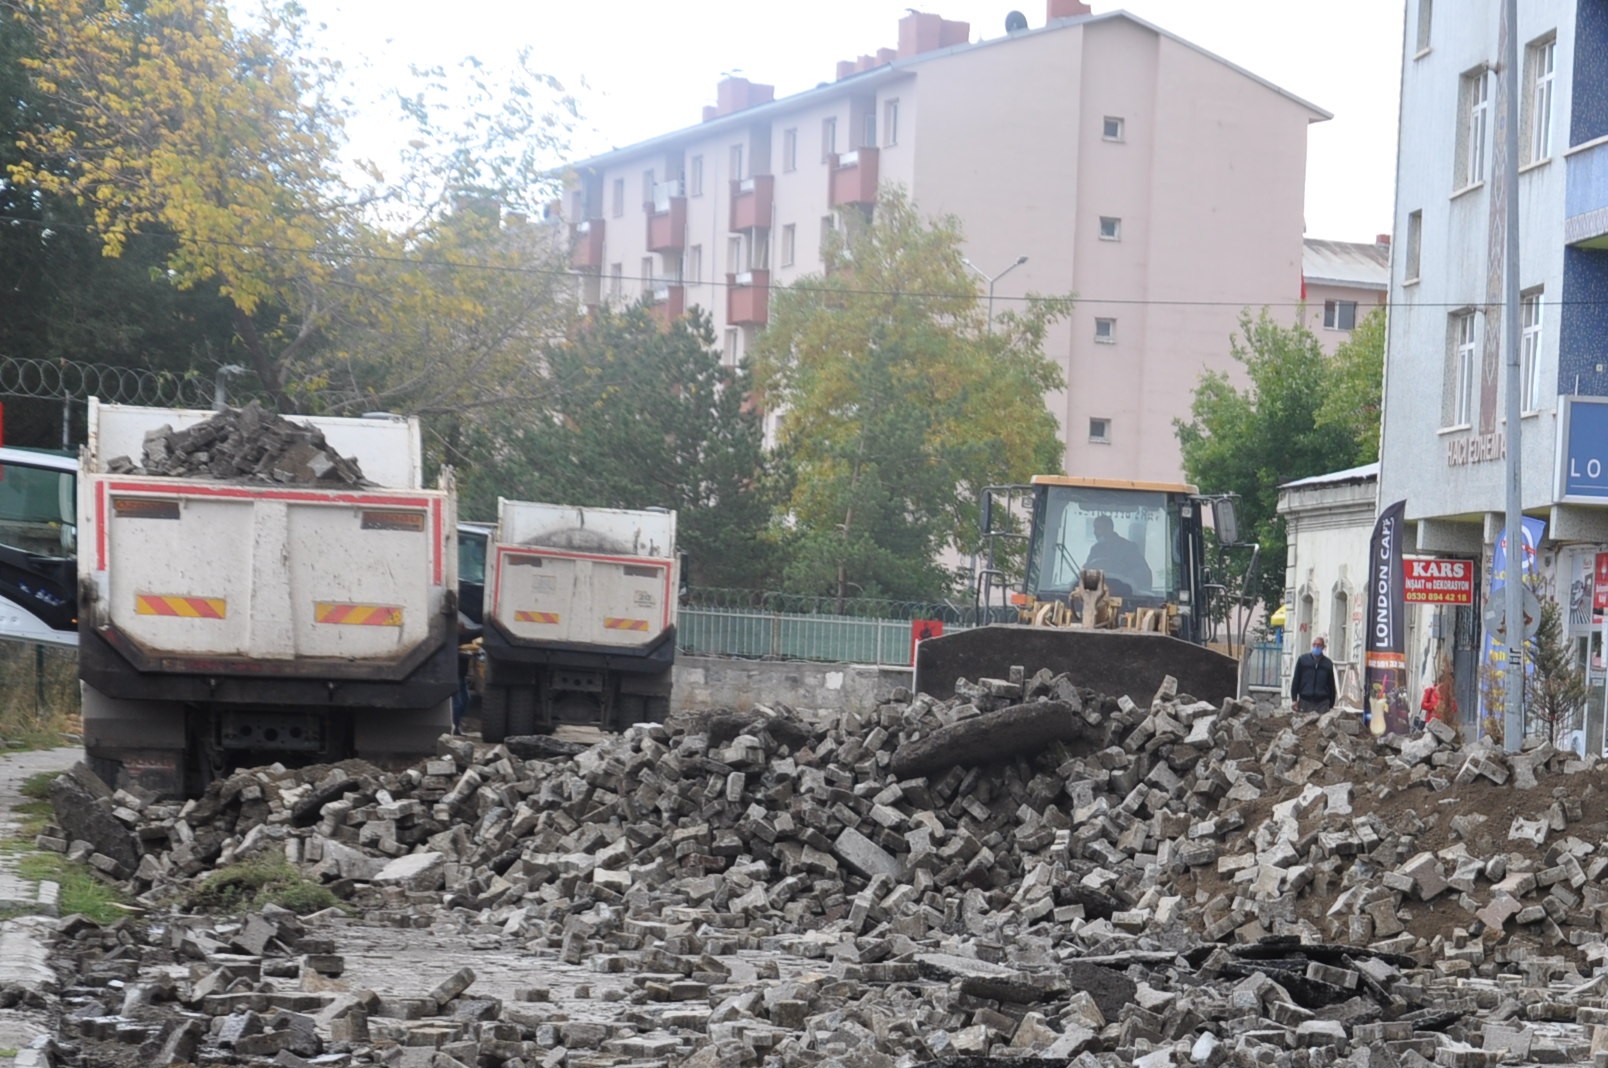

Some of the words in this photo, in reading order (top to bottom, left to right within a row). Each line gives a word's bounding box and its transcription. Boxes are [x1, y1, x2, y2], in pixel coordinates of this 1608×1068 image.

[1412, 561, 1465, 578] KARS
[1433, 579, 1470, 591] DEKORASYON
[1376, 565, 1390, 647] LONDON
